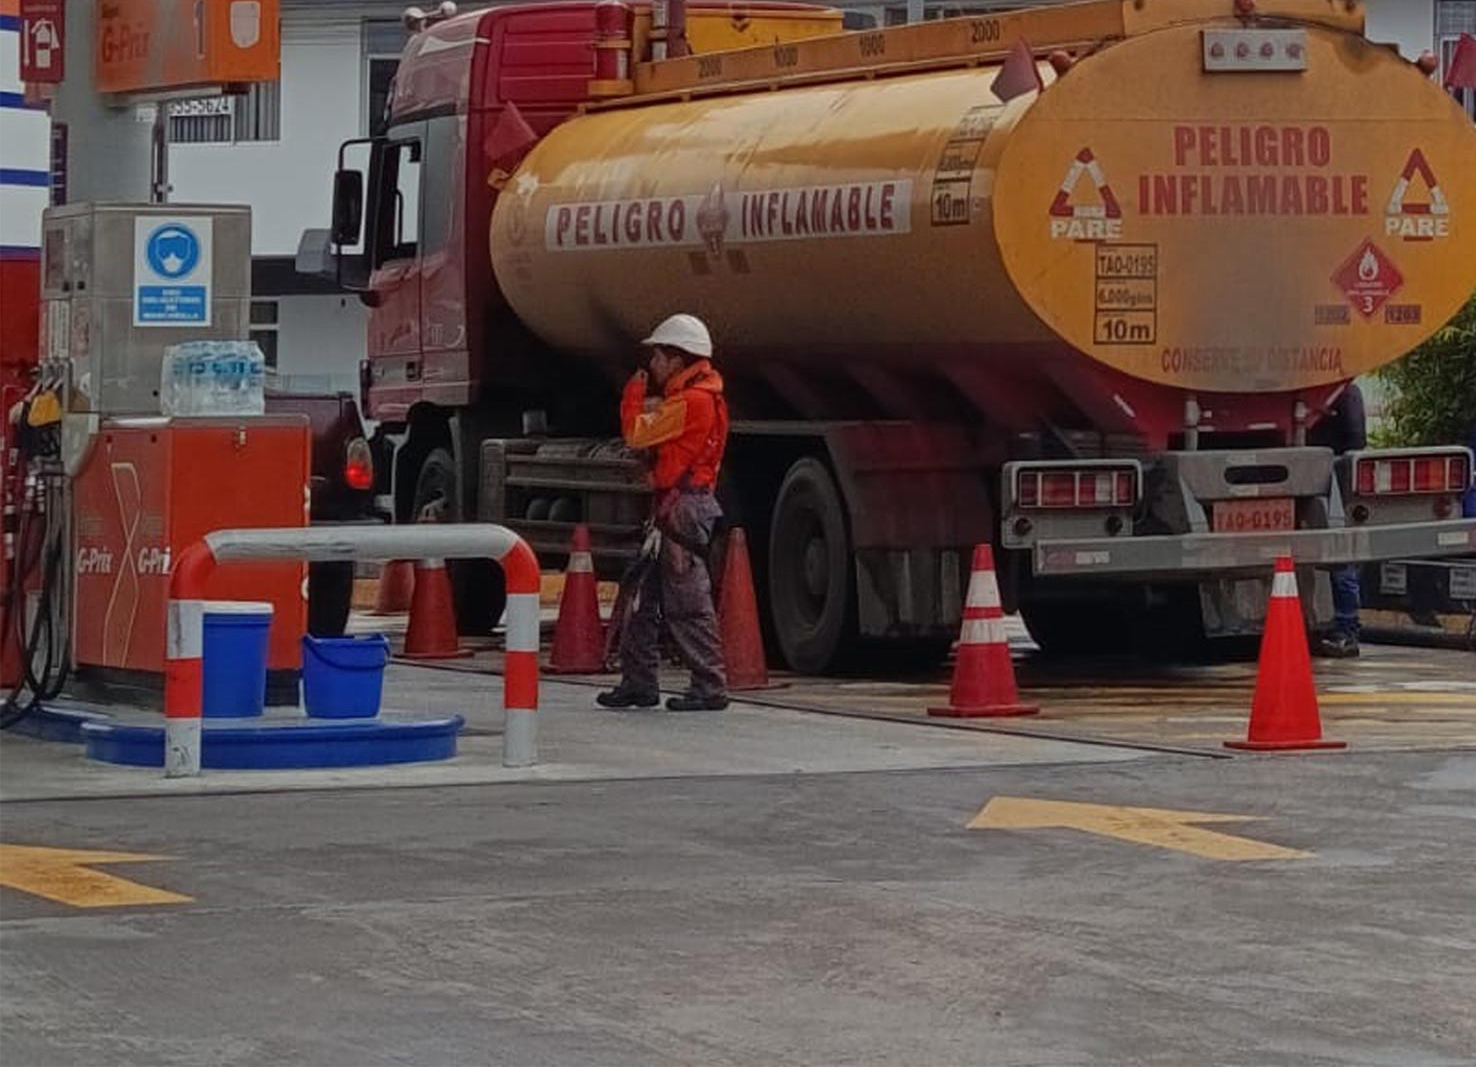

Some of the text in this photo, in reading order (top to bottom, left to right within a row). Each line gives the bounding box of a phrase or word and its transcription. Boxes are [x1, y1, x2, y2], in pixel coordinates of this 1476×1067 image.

[970, 20, 1001, 45] 2000
[1174, 126, 1331, 168] PELIGRO
[1138, 174, 1369, 216] INFLAMABLE
[555, 199, 686, 247] PELIGRO
[741, 184, 895, 239] INFLAMABLE
[1385, 217, 1449, 237] PARE
[1051, 219, 1122, 240] PARE
[1362, 295, 1374, 313] 3
[1103, 319, 1151, 340] 10m
